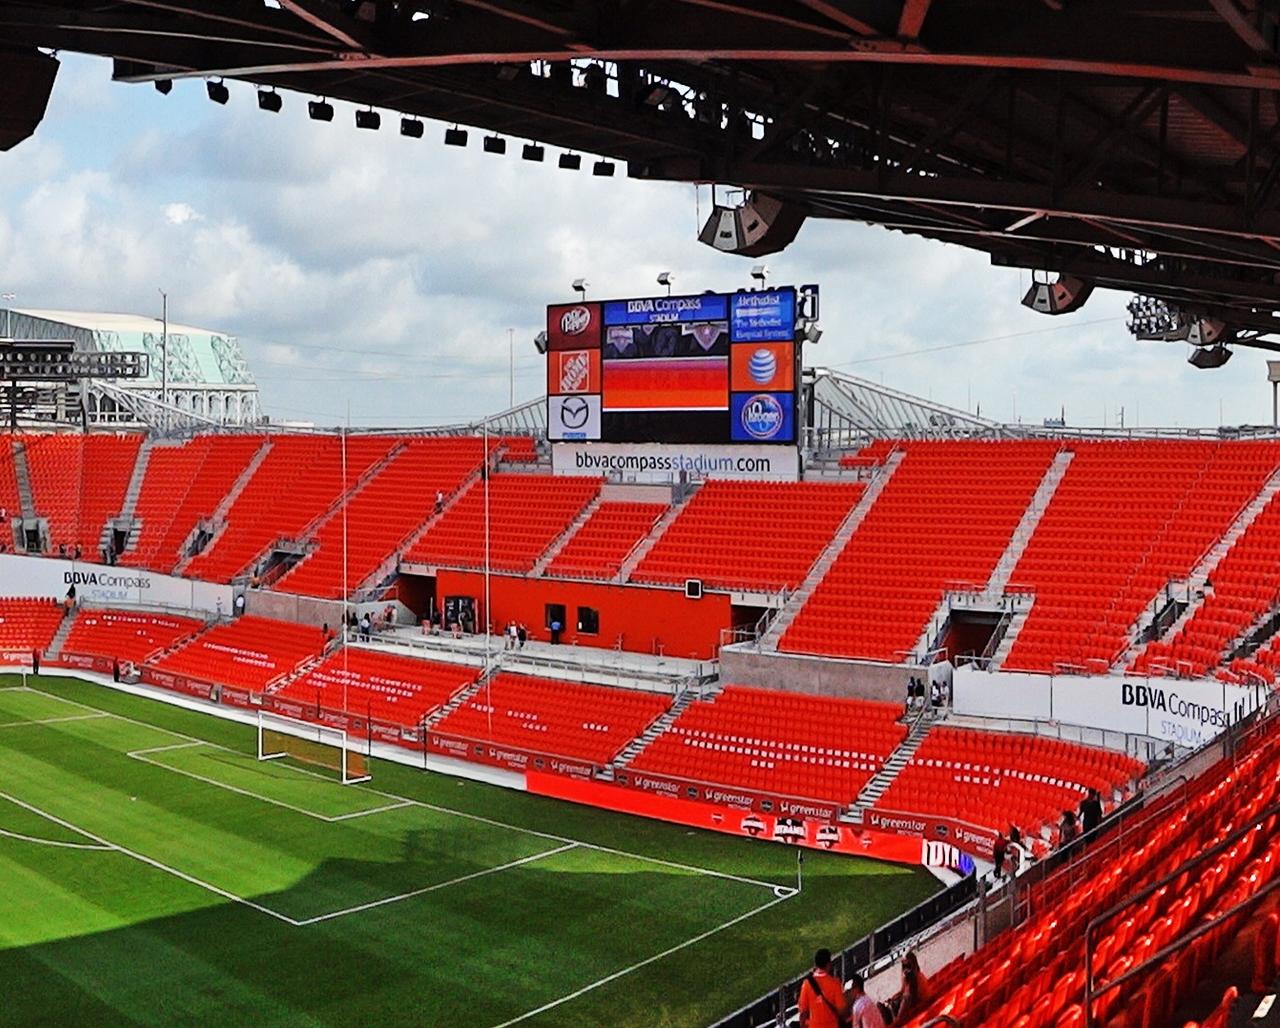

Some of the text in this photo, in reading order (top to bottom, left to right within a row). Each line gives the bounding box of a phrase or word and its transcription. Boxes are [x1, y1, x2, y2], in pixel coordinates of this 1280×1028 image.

[655, 298, 702, 312] Compass
[575, 451, 771, 473] bbvacompassstadium.com
[64, 571, 151, 589] BBVA Compass
[1122, 684, 1167, 712] BBVA
[713, 792, 754, 806] greenstar
[789, 803, 833, 818] greenstar
[880, 816, 927, 831] greenstar
